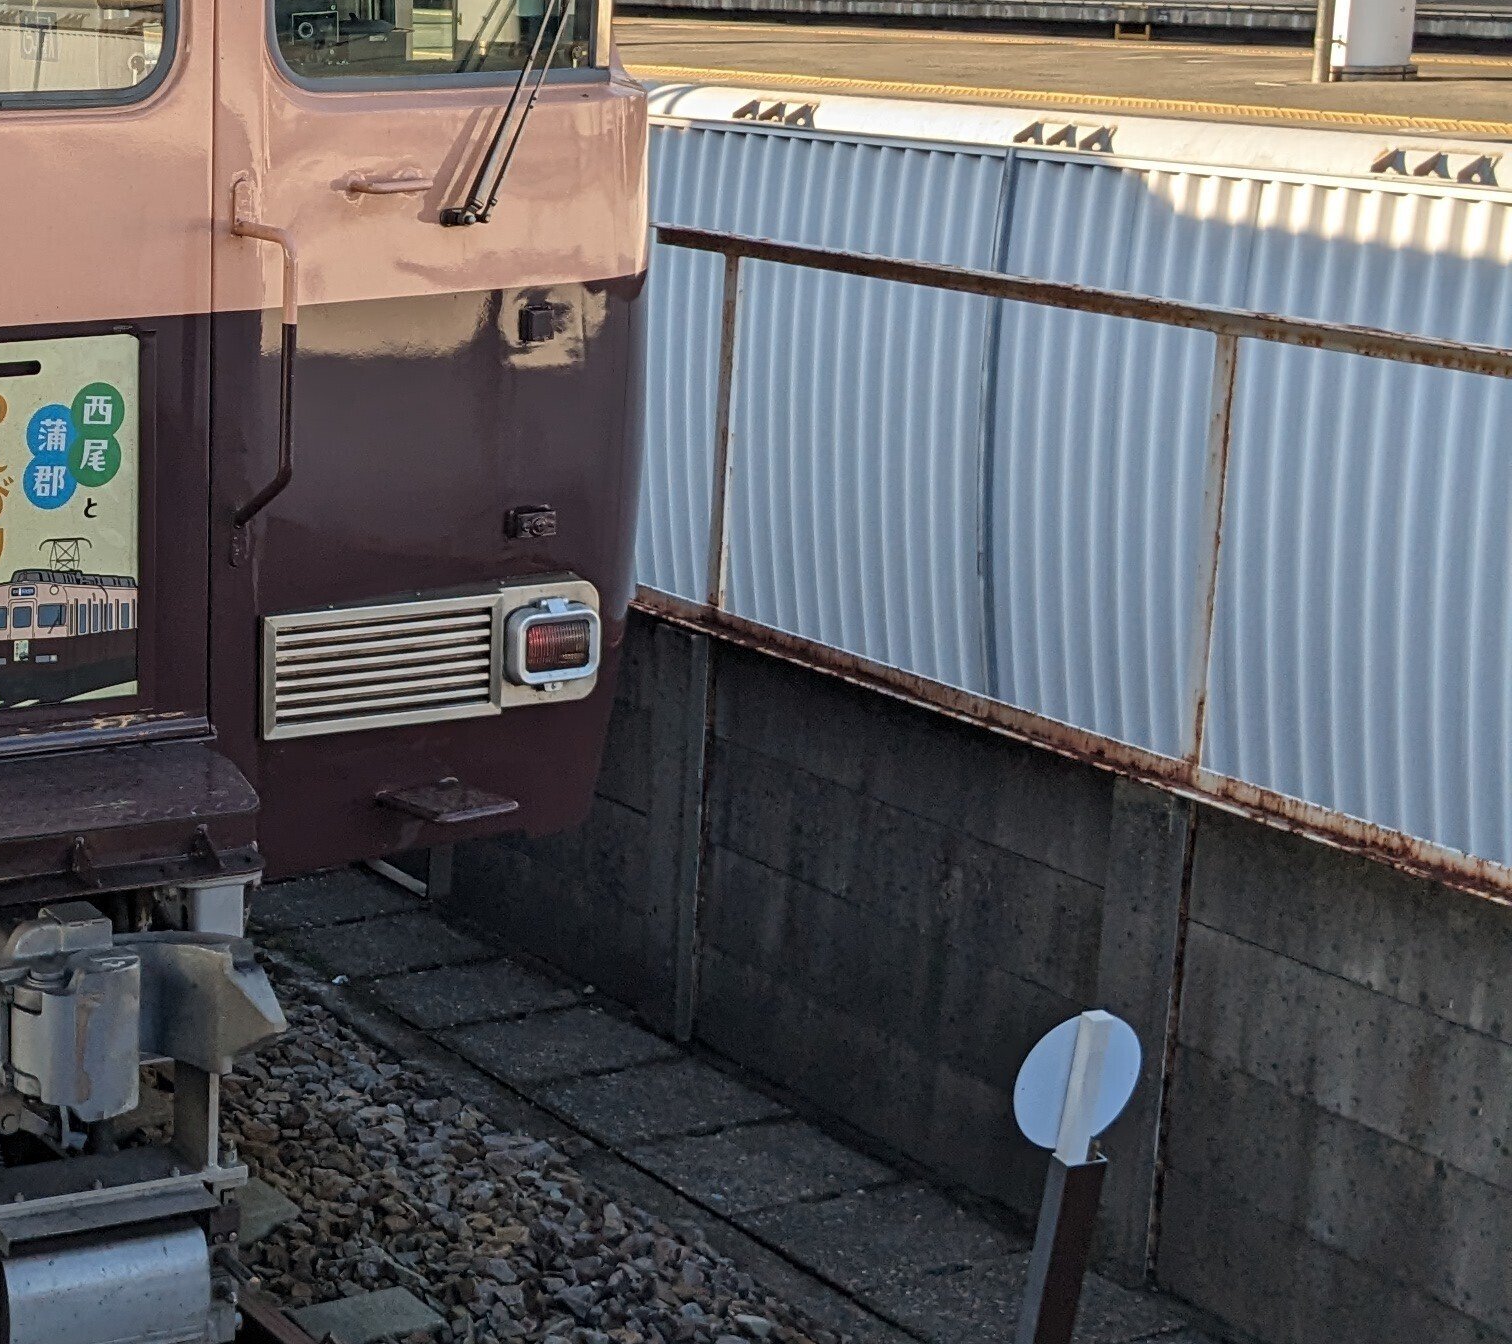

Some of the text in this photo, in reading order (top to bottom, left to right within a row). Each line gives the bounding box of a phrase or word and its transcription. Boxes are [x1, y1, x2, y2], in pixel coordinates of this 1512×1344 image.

[32, 417, 67, 498] 蒲郡
[79, 394, 113, 519] 西尾 と
